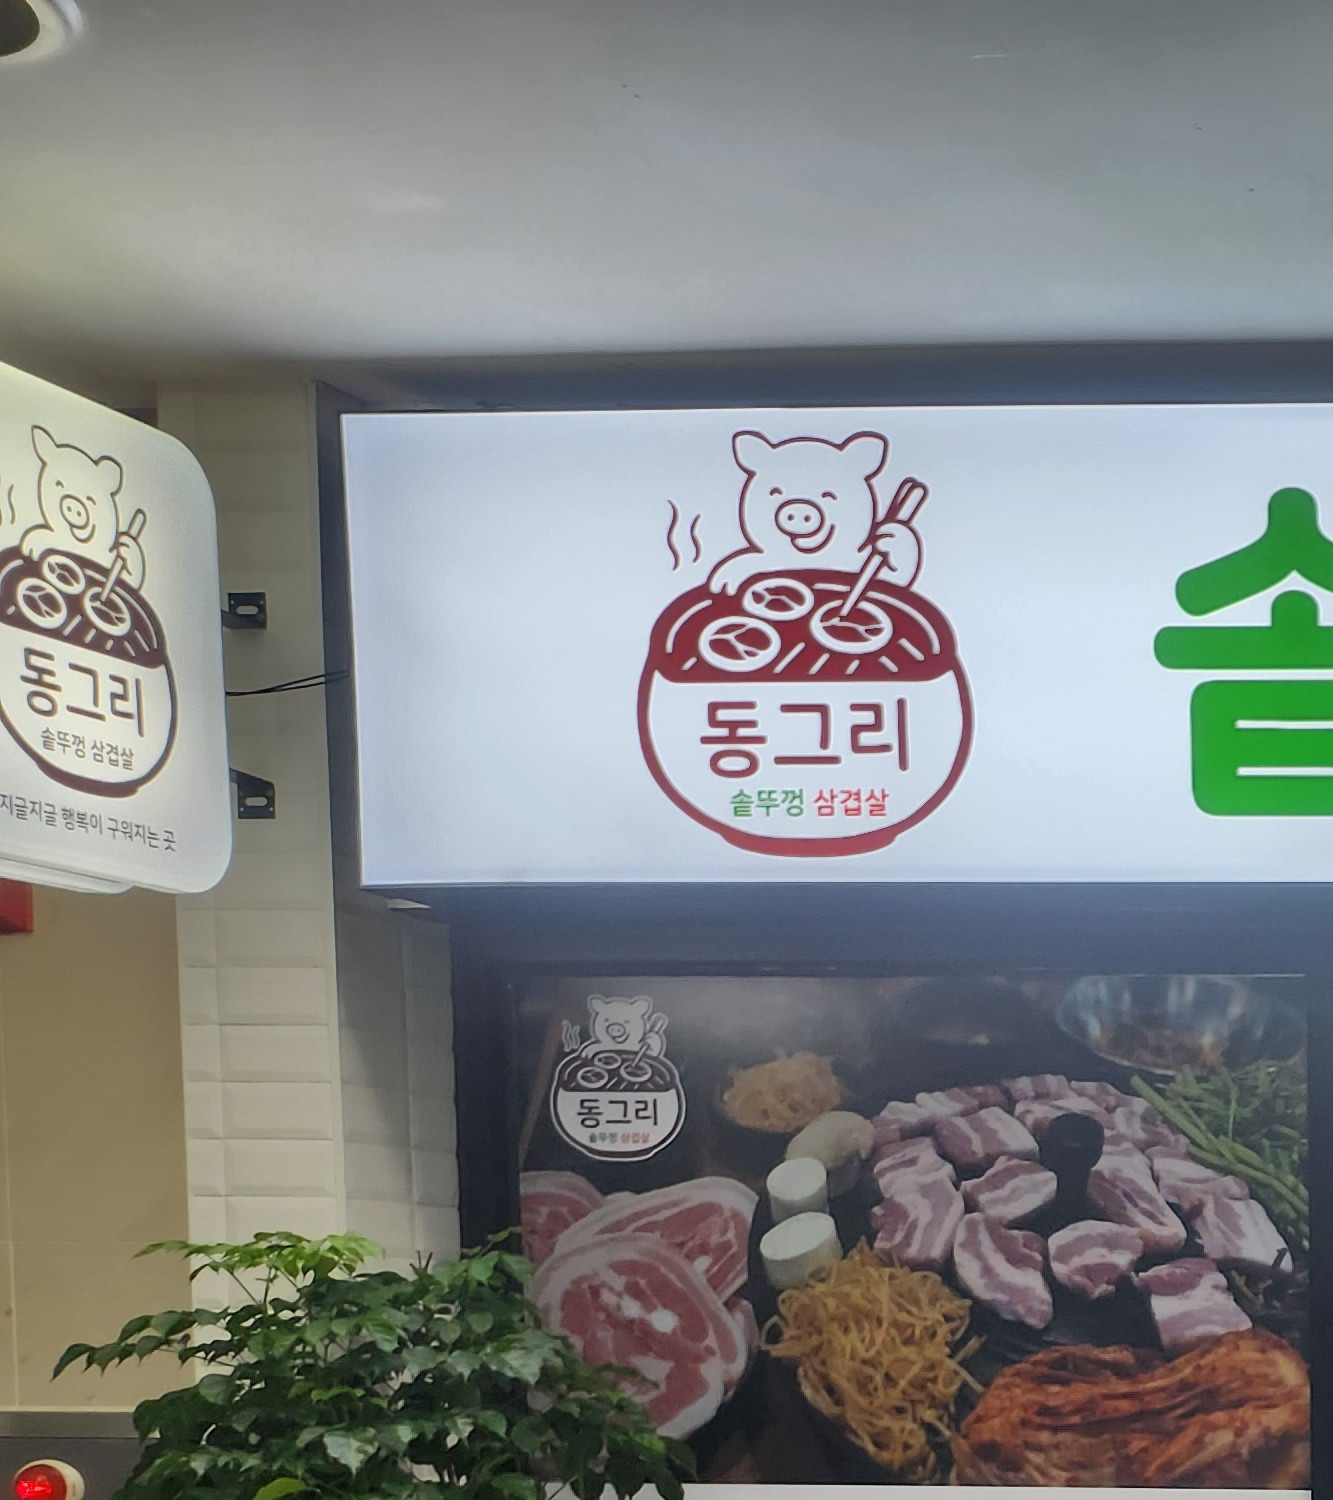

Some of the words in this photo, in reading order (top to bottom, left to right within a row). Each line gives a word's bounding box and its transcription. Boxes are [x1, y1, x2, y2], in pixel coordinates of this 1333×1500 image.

[20, 646, 145, 738] 동그리
[39, 726, 87, 760] 솥뚜껑
[91, 737, 135, 771] 삼겹살
[699, 697, 911, 779] 동그리
[730, 787, 805, 818] 솥뚜껑
[812, 787, 890, 818] 삼겹살
[61, 807, 104, 837] 행복이
[107, 817, 161, 849] 구워지는
[162, 829, 178, 853] 곳
[577, 1098, 659, 1129] 동그리
